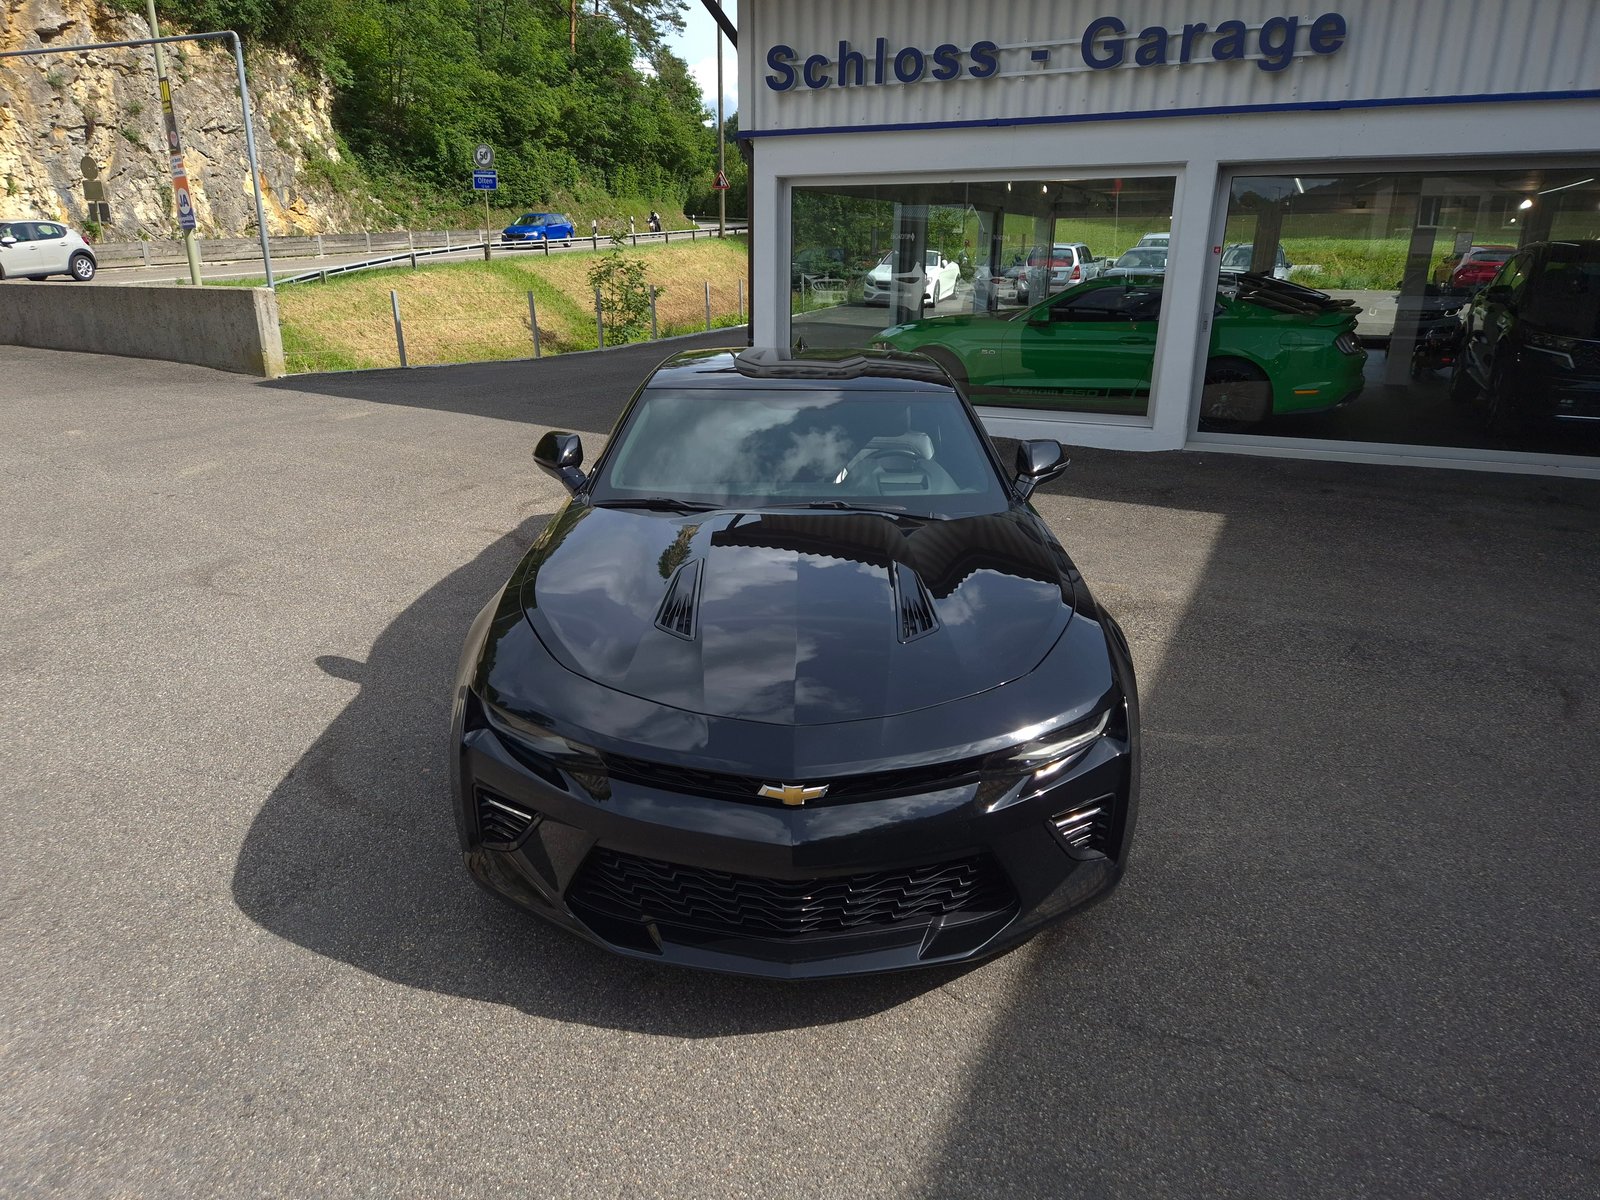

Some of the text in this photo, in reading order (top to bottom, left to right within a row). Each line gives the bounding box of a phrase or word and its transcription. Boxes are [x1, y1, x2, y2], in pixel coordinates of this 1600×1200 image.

[765, 12, 1348, 93] Schloss - Garage
[479, 151, 488, 161] 50
[477, 177, 493, 185] Olten
[179, 194, 190, 208] JA
